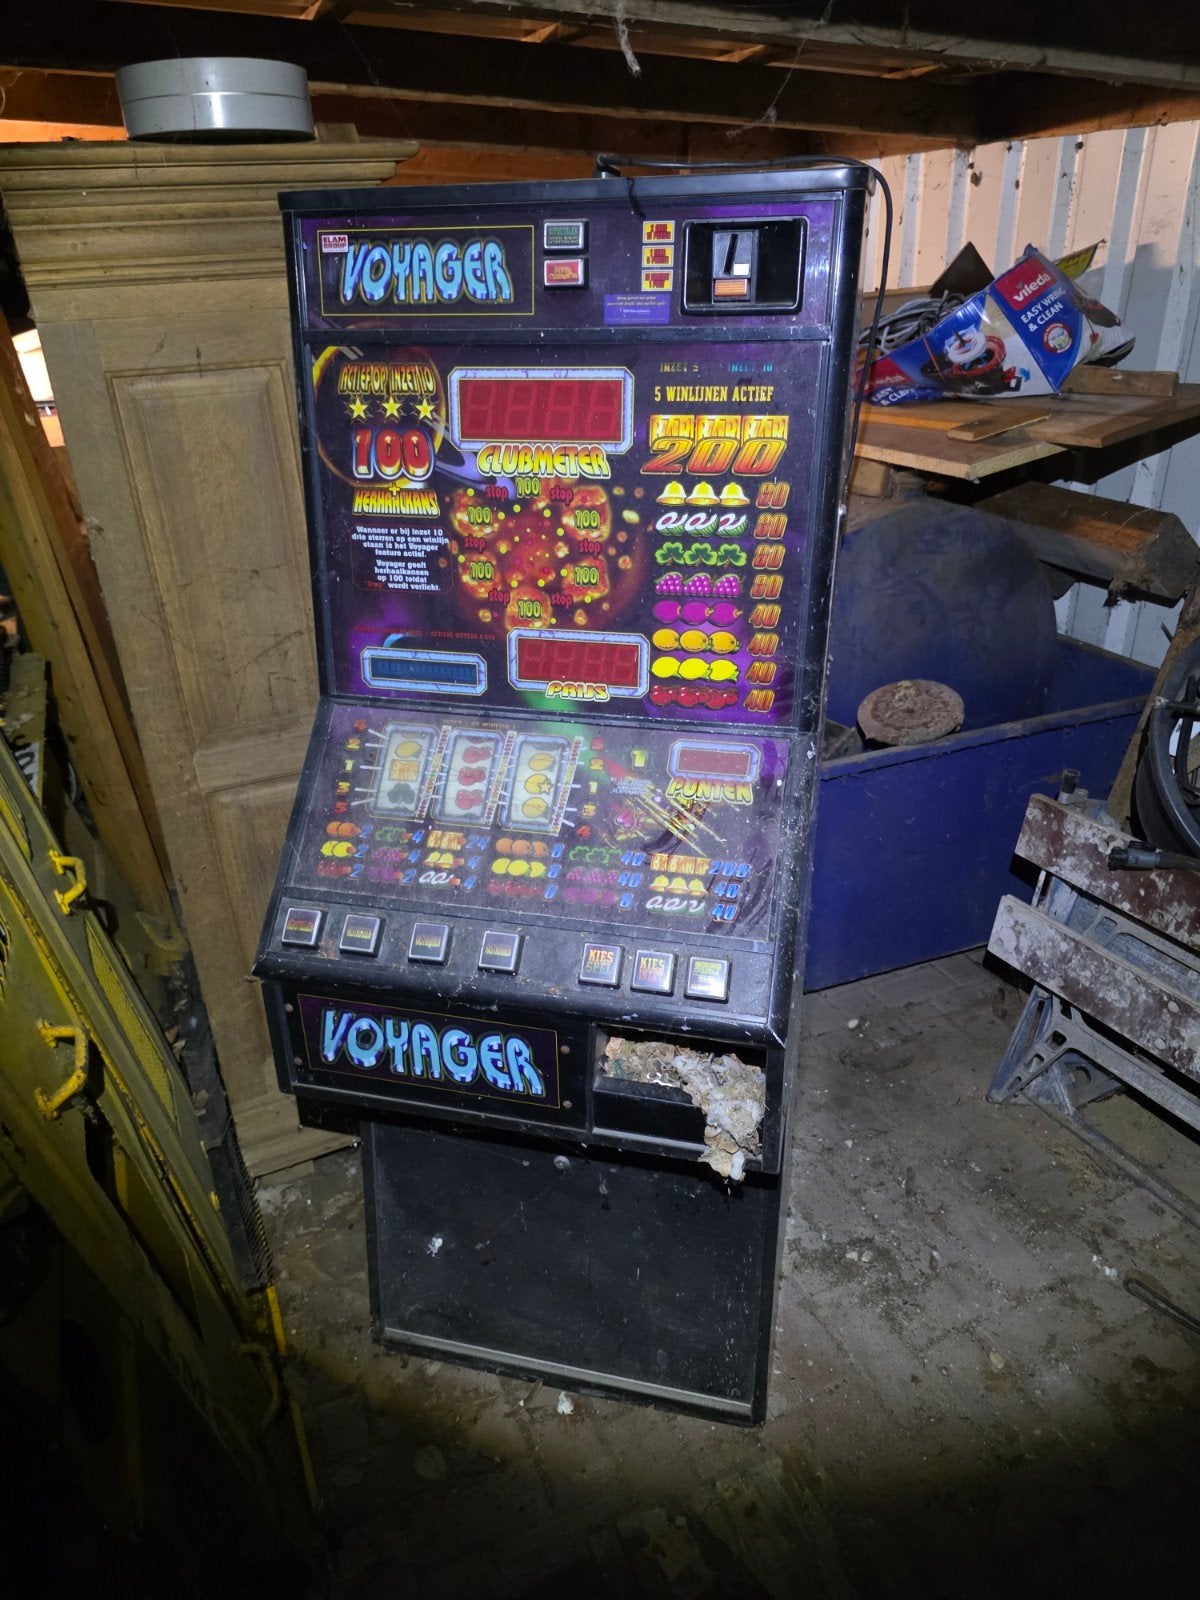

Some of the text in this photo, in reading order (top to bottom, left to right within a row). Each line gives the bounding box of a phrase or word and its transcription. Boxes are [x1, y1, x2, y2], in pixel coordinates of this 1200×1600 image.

[340, 238, 514, 304] VOYAGER
[1012, 273, 1051, 302] vileda
[1021, 287, 1066, 324] EASY WRING
[1028, 301, 1064, 332] & CLEAN
[340, 365, 371, 393] ACTIEF
[372, 365, 388, 393] OP
[654, 385, 774, 402] 5 WINLIJNEN ACTIEF
[354, 429, 434, 480] 100
[477, 443, 611, 479] CLUBMETER
[640, 438, 787, 476] 200
[516, 478, 540, 498] 100
[467, 507, 492, 525] 100
[574, 510, 599, 529] 100
[351, 533, 366, 541] drie
[423, 537, 449, 545] winlijn
[356, 526, 388, 535] Wanneer
[390, 527, 398, 535] er
[400, 527, 410, 536] bij
[412, 528, 431, 536] inzet
[363, 541, 384, 549] staan
[408, 543, 438, 552] Voyager
[375, 549, 401, 557] feature
[374, 566, 429, 577] herhaalkansen
[376, 559, 427, 570] Voyager geeft
[470, 563, 494, 580] 100
[377, 575, 386, 583] op
[389, 574, 403, 582] 100
[388, 582, 409, 590] wordt
[574, 568, 599, 586] 100
[518, 601, 542, 619] 100
[545, 681, 610, 702] PRIJS
[590, 759, 603, 771] 2
[632, 749, 647, 769] 1
[589, 781, 598, 794] 1
[666, 777, 754, 805] PUNTEN
[588, 949, 614, 963] KIES
[640, 956, 665, 971] KIES
[321, 1008, 545, 1097] VOYAGER
